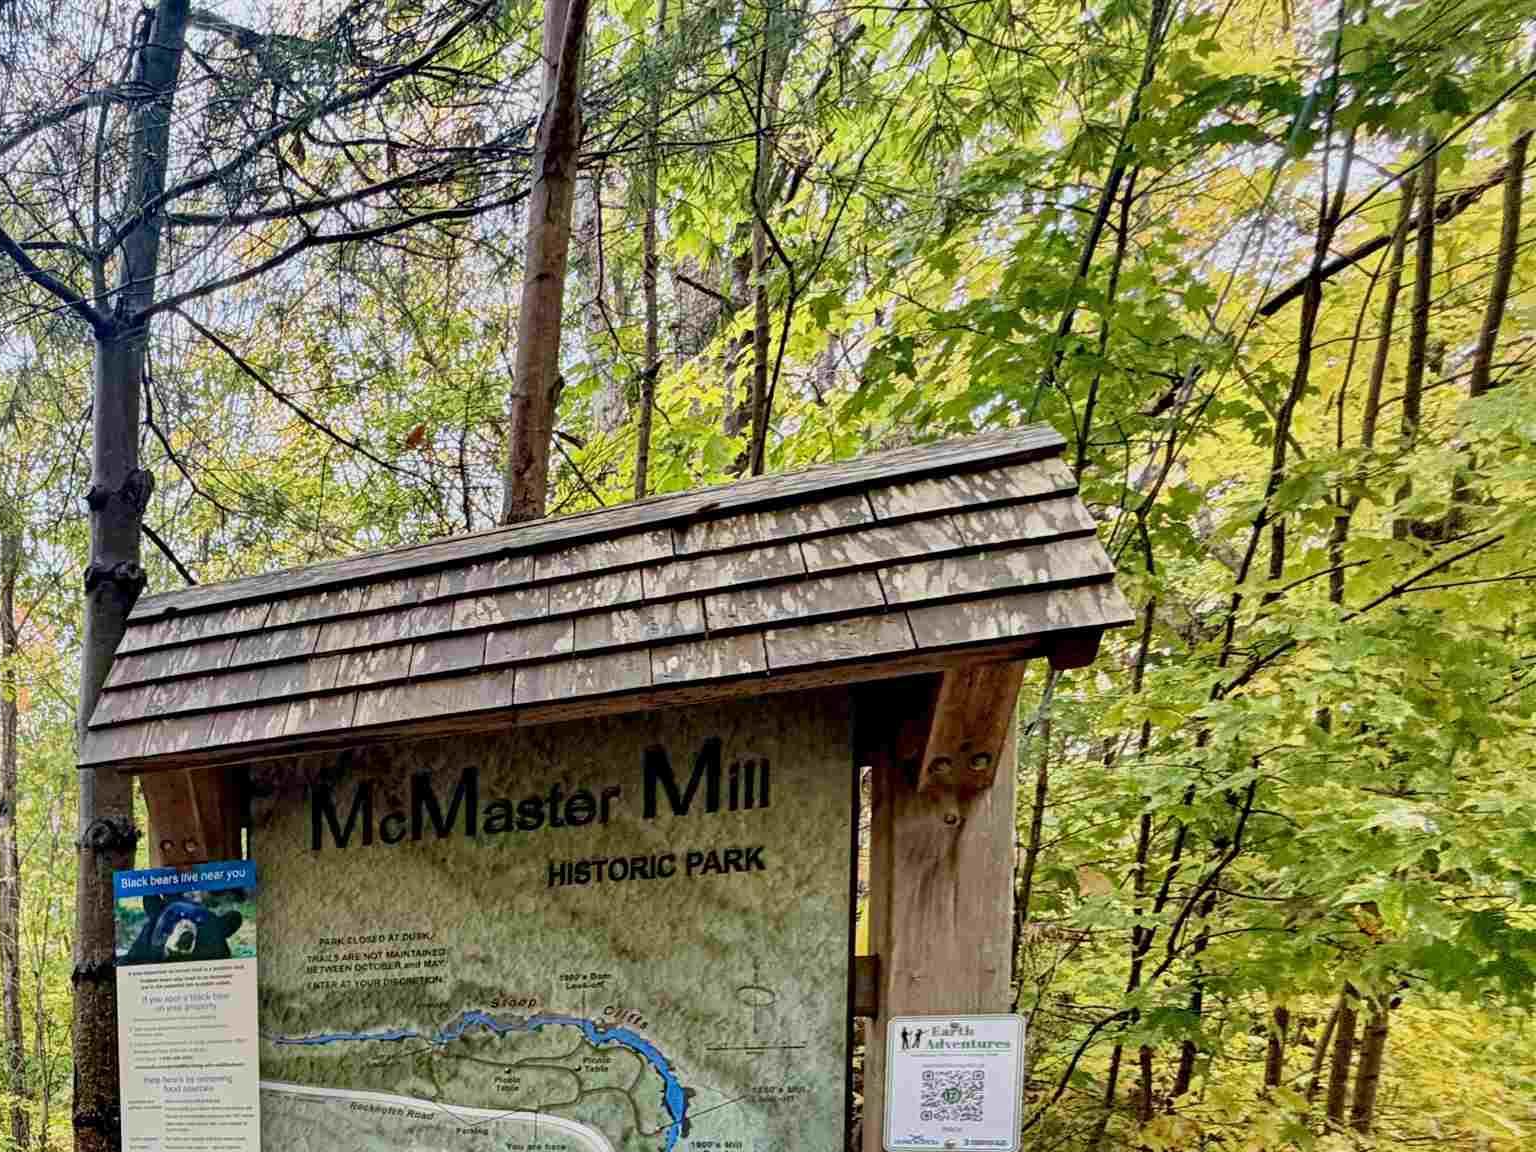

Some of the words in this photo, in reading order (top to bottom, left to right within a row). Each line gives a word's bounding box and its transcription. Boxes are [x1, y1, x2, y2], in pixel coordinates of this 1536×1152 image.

[311, 766, 621, 850] McMaster
[641, 736, 770, 819] Mill
[547, 854, 676, 887] HISTORIC
[685, 846, 766, 875] PARK
[121, 877, 148, 889] Black
[150, 874, 179, 886] bears
[181, 872, 199, 883] live
[200, 870, 225, 881] near
[226, 867, 247, 881] you
[319, 936, 345, 945] PARK
[347, 935, 384, 944] CLOSED
[389, 933, 399, 941] AT
[306, 953, 339, 962] TRAILS
[342, 952, 361, 960] ARE
[364, 951, 382, 960] NOT
[386, 948, 446, 959] MAINTAINED
[306, 963, 352, 974] BETWEEN
[354, 961, 401, 971] OCTOBER
[404, 961, 421, 969] and
[491, 993, 537, 1008] Steep
[603, 1005, 649, 1030] Cliffs
[931, 1024, 974, 1037] Earth
[927, 1038, 1011, 1050] Adventures
[406, 1109, 434, 1120] Road
[506, 1143, 524, 1151] You
[526, 1143, 542, 1151] are
[544, 1143, 567, 1151] here
[724, 1141, 743, 1149] Mill
